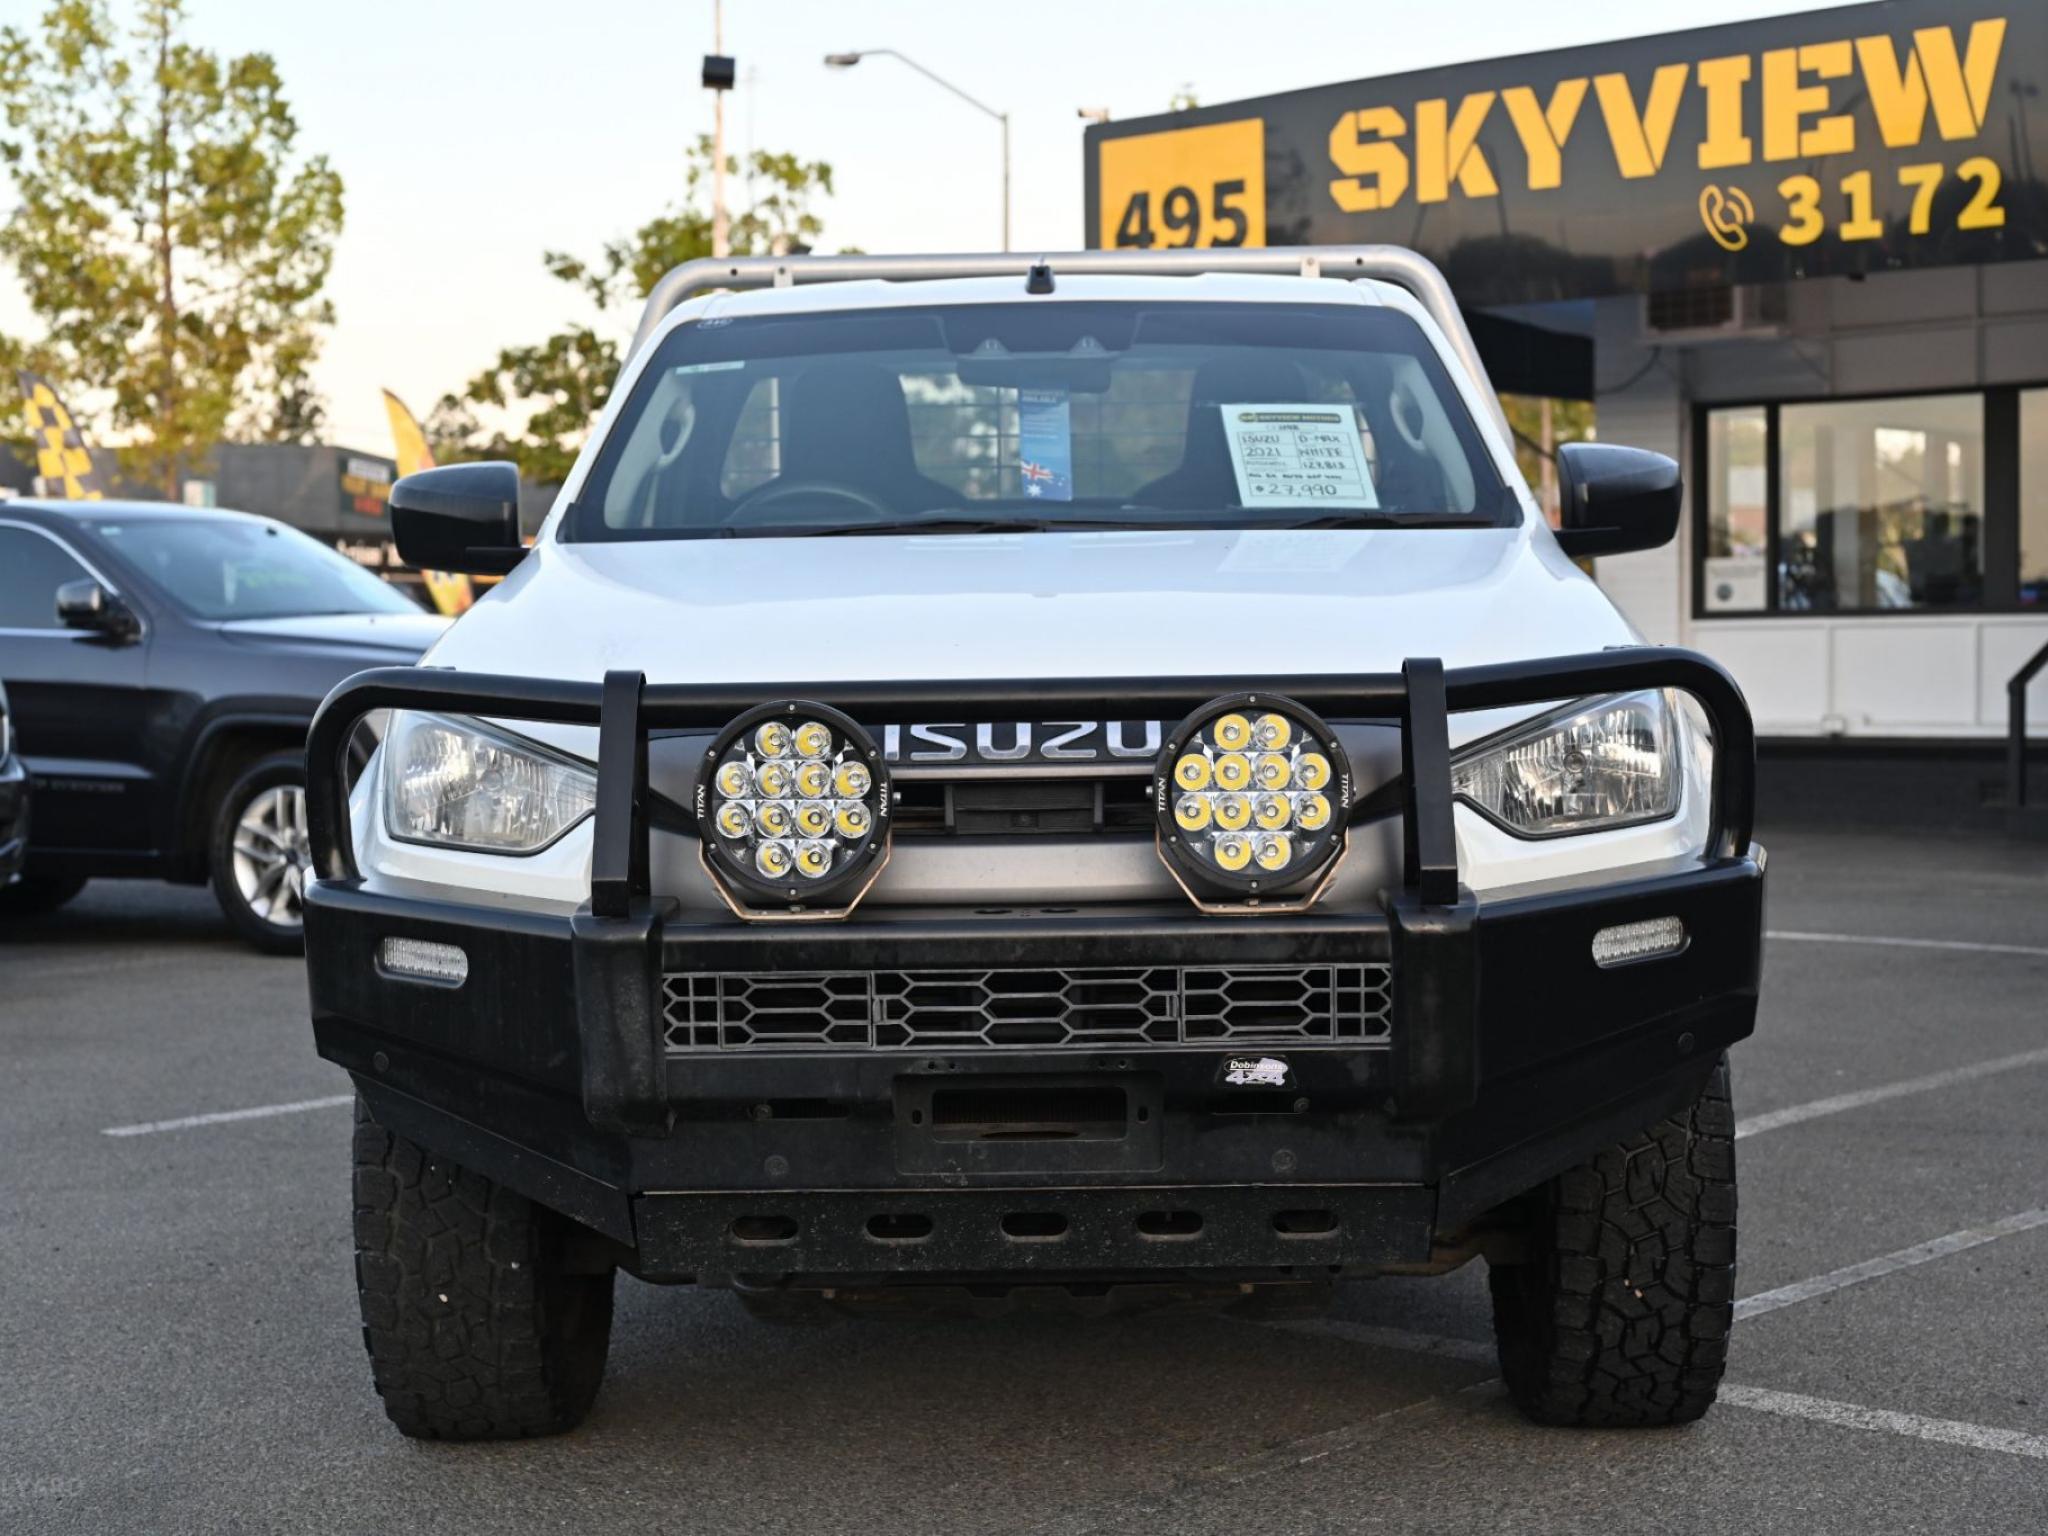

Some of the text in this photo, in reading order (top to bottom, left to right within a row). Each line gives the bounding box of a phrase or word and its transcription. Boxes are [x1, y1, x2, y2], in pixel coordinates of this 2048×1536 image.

[1329, 18, 2007, 213] SKYVIEW
[1115, 178, 1248, 248] 495
[1777, 157, 2005, 246] 3172
[1242, 434, 1280, 444] ISUZU
[885, 721, 1161, 761] ISUZU
[697, 784, 705, 820] TITAN
[880, 782, 888, 817] TITAN
[1158, 776, 1166, 812] TITAN
[1341, 773, 1349, 808] TITAN
